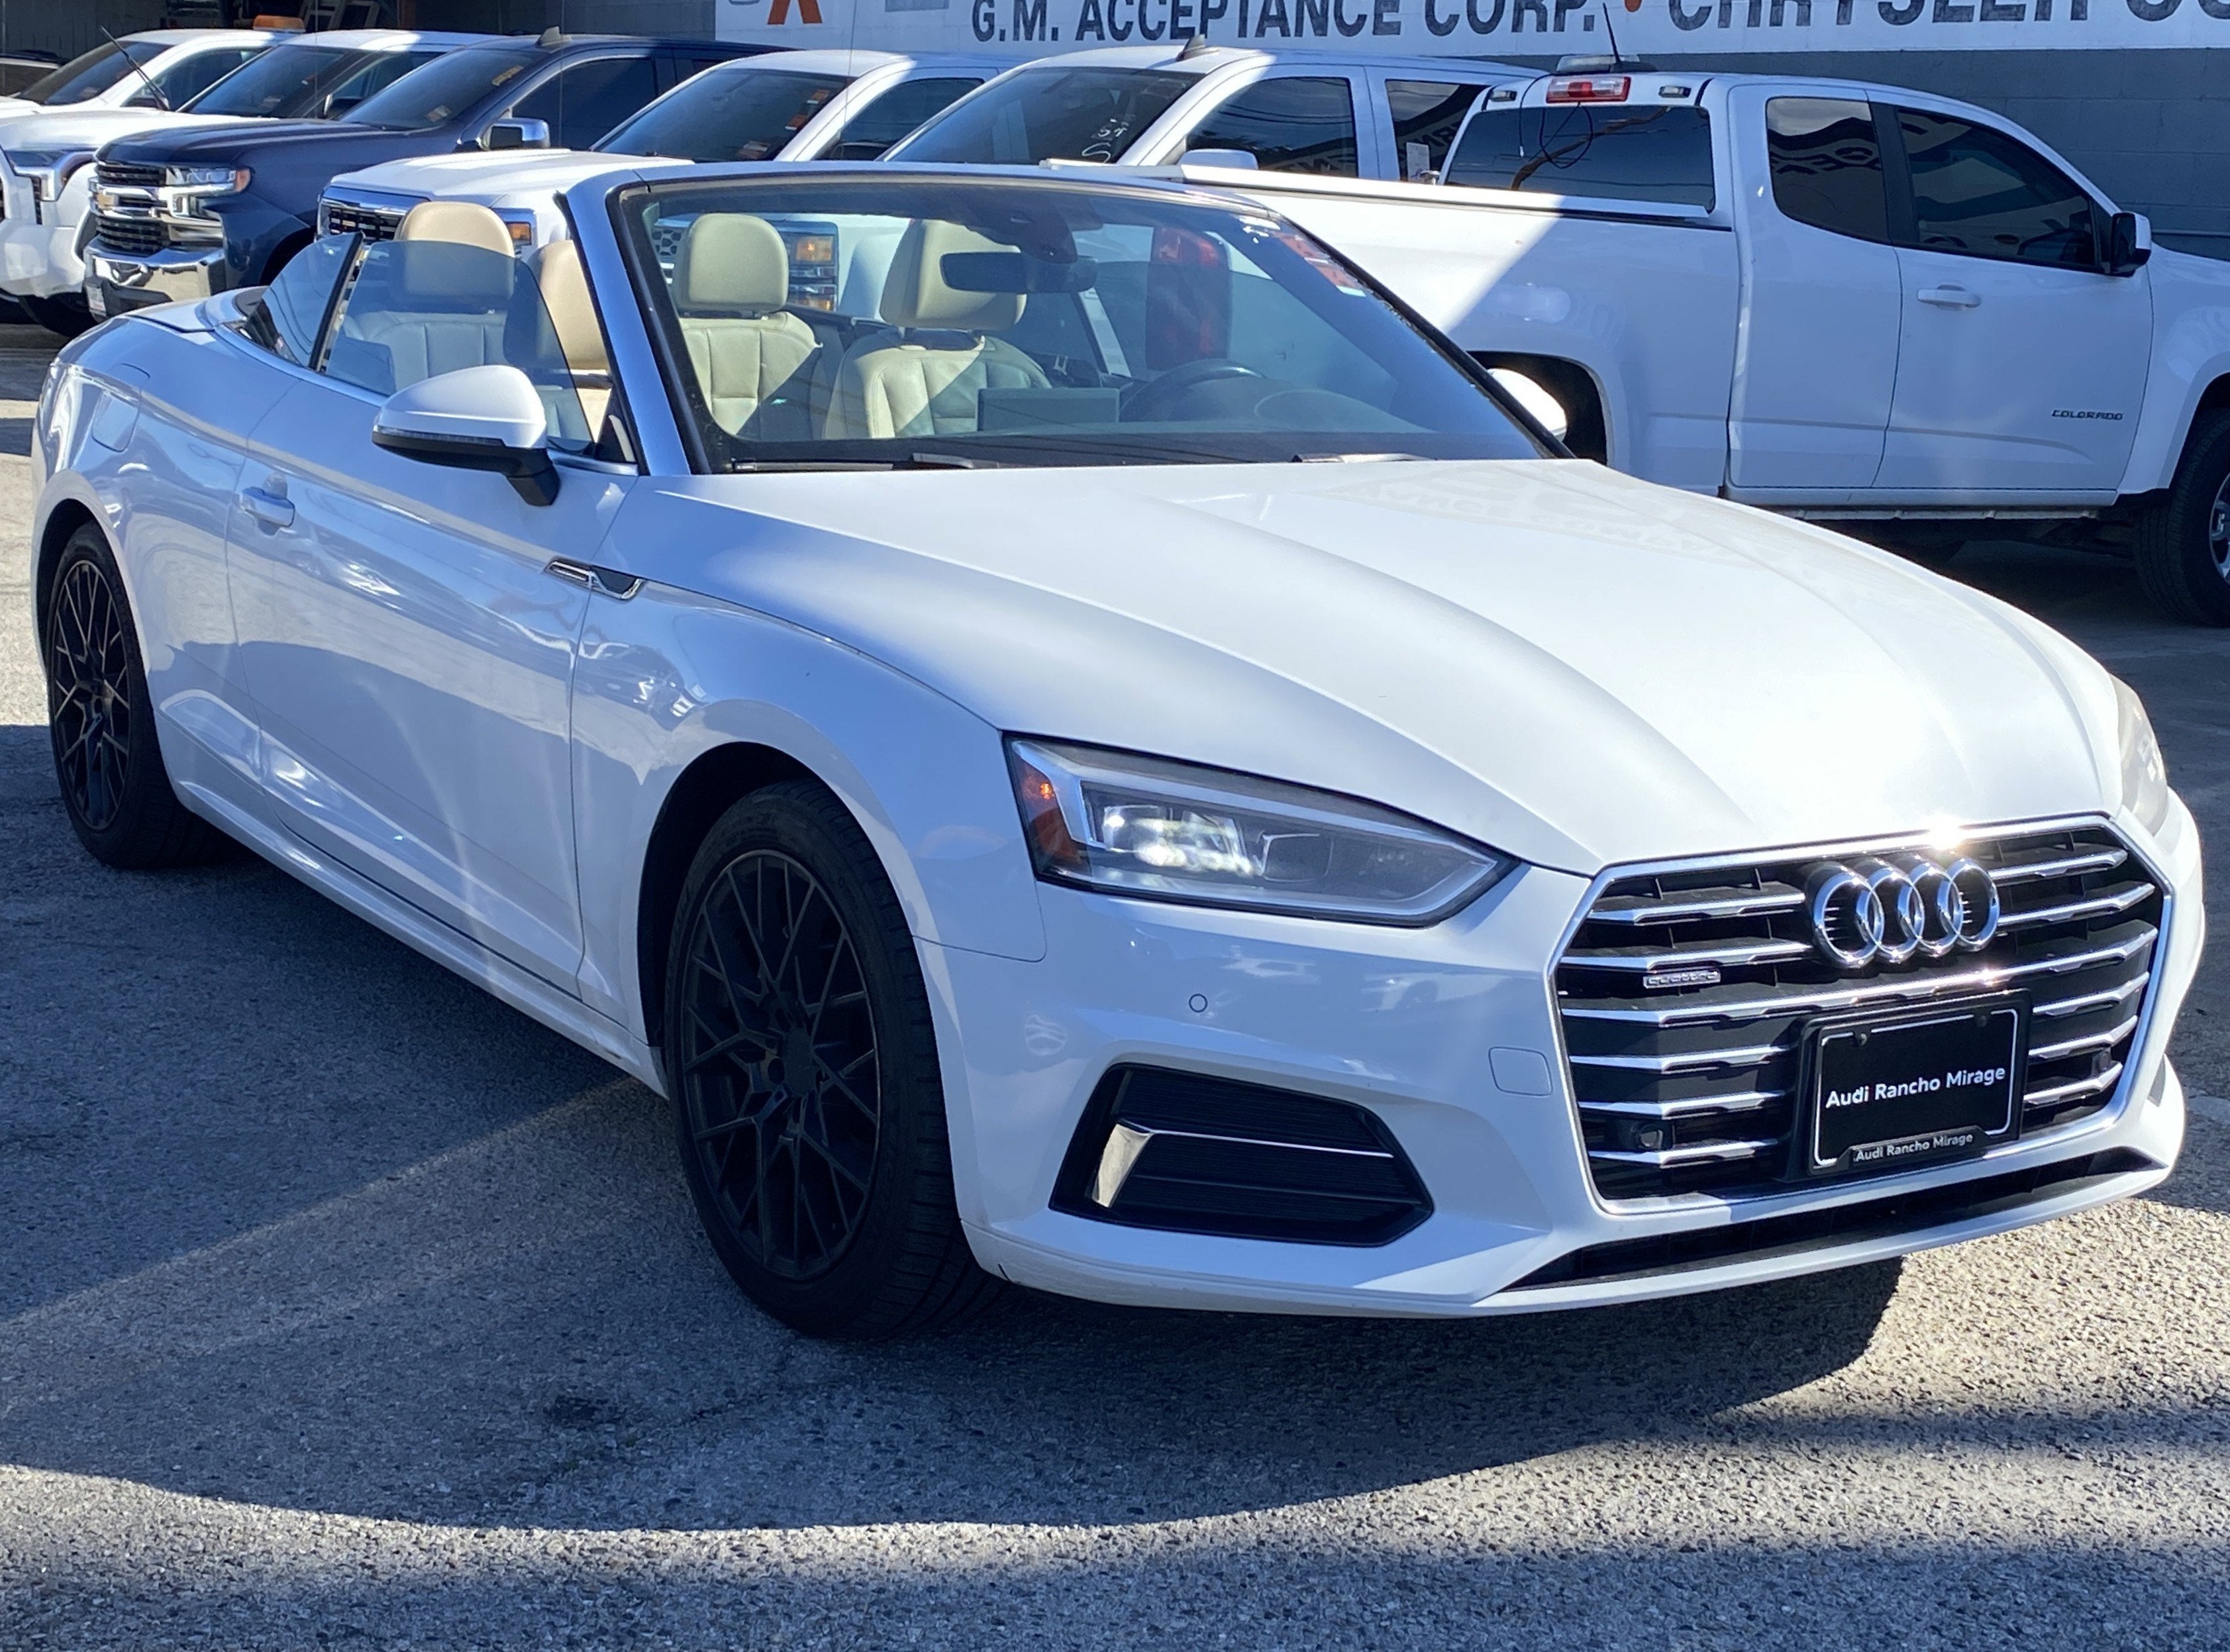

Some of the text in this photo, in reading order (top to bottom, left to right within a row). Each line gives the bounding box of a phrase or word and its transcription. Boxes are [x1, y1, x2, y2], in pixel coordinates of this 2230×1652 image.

[972, 0, 1059, 42] G.M.
[2051, 409, 2123, 421] COLORADO
[1825, 1068, 2005, 1108] Audi Rancho Mirage
[1854, 1133, 1974, 1162] Audi Rancho Mirage
